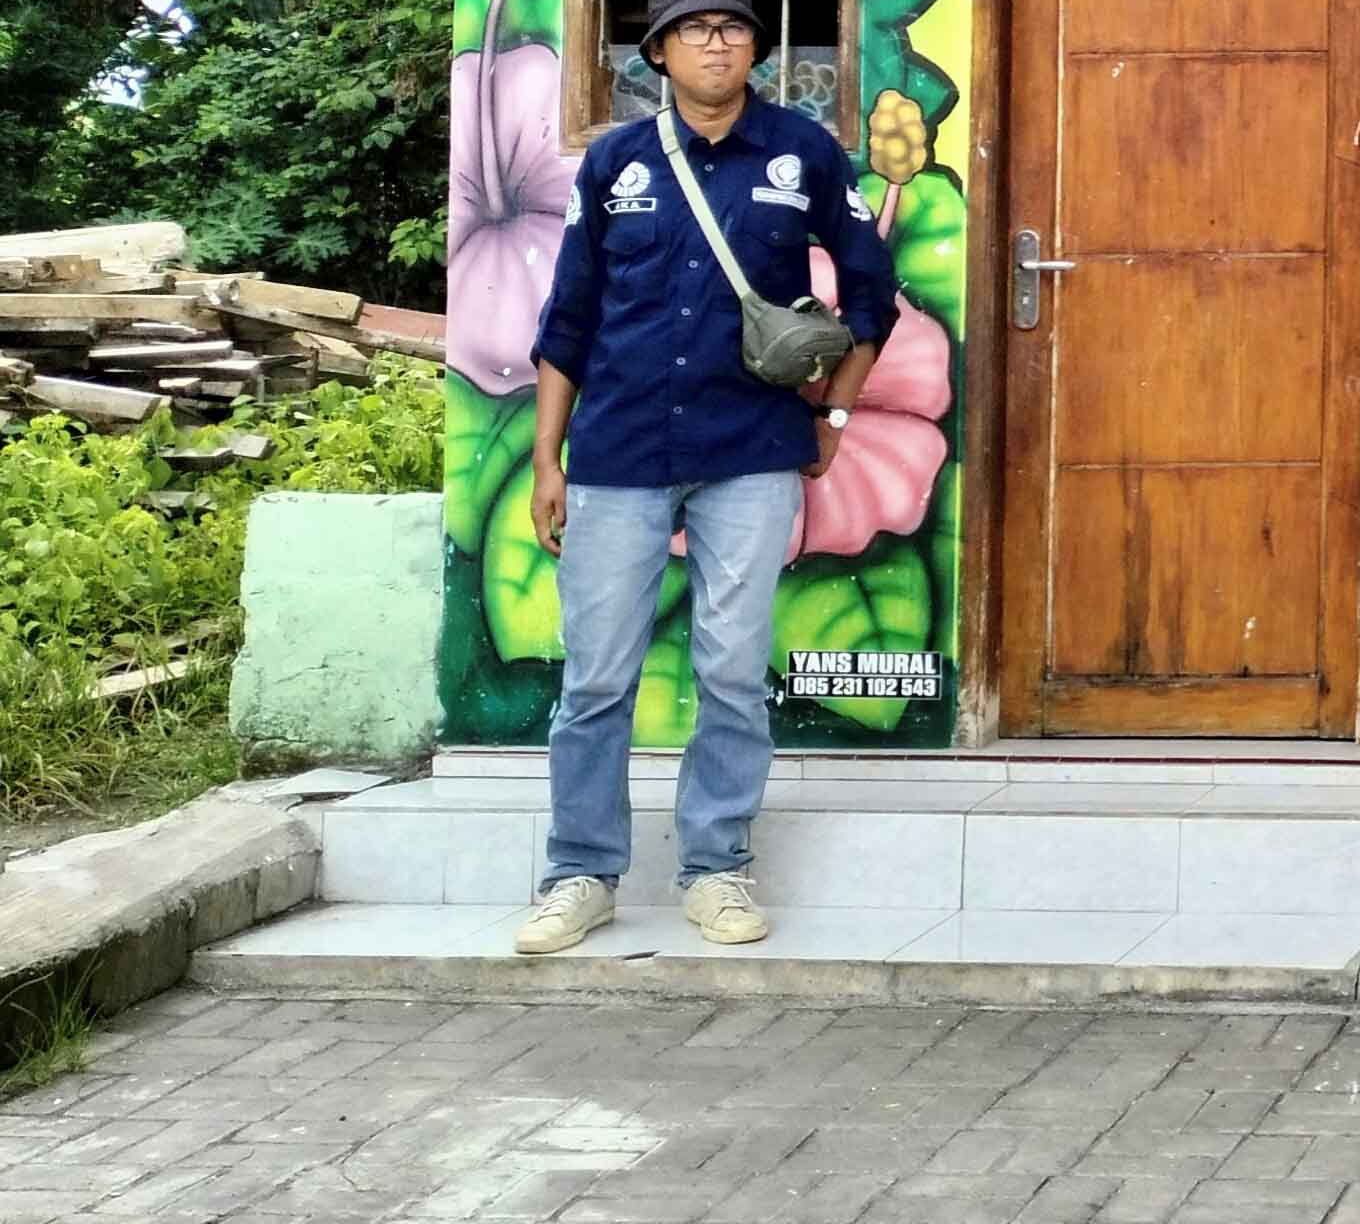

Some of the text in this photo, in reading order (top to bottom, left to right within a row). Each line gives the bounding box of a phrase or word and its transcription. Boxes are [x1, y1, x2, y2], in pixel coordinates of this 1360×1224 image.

[792, 652, 936, 674] YANS MURAL
[793, 677, 936, 697] 085 231 102 543
